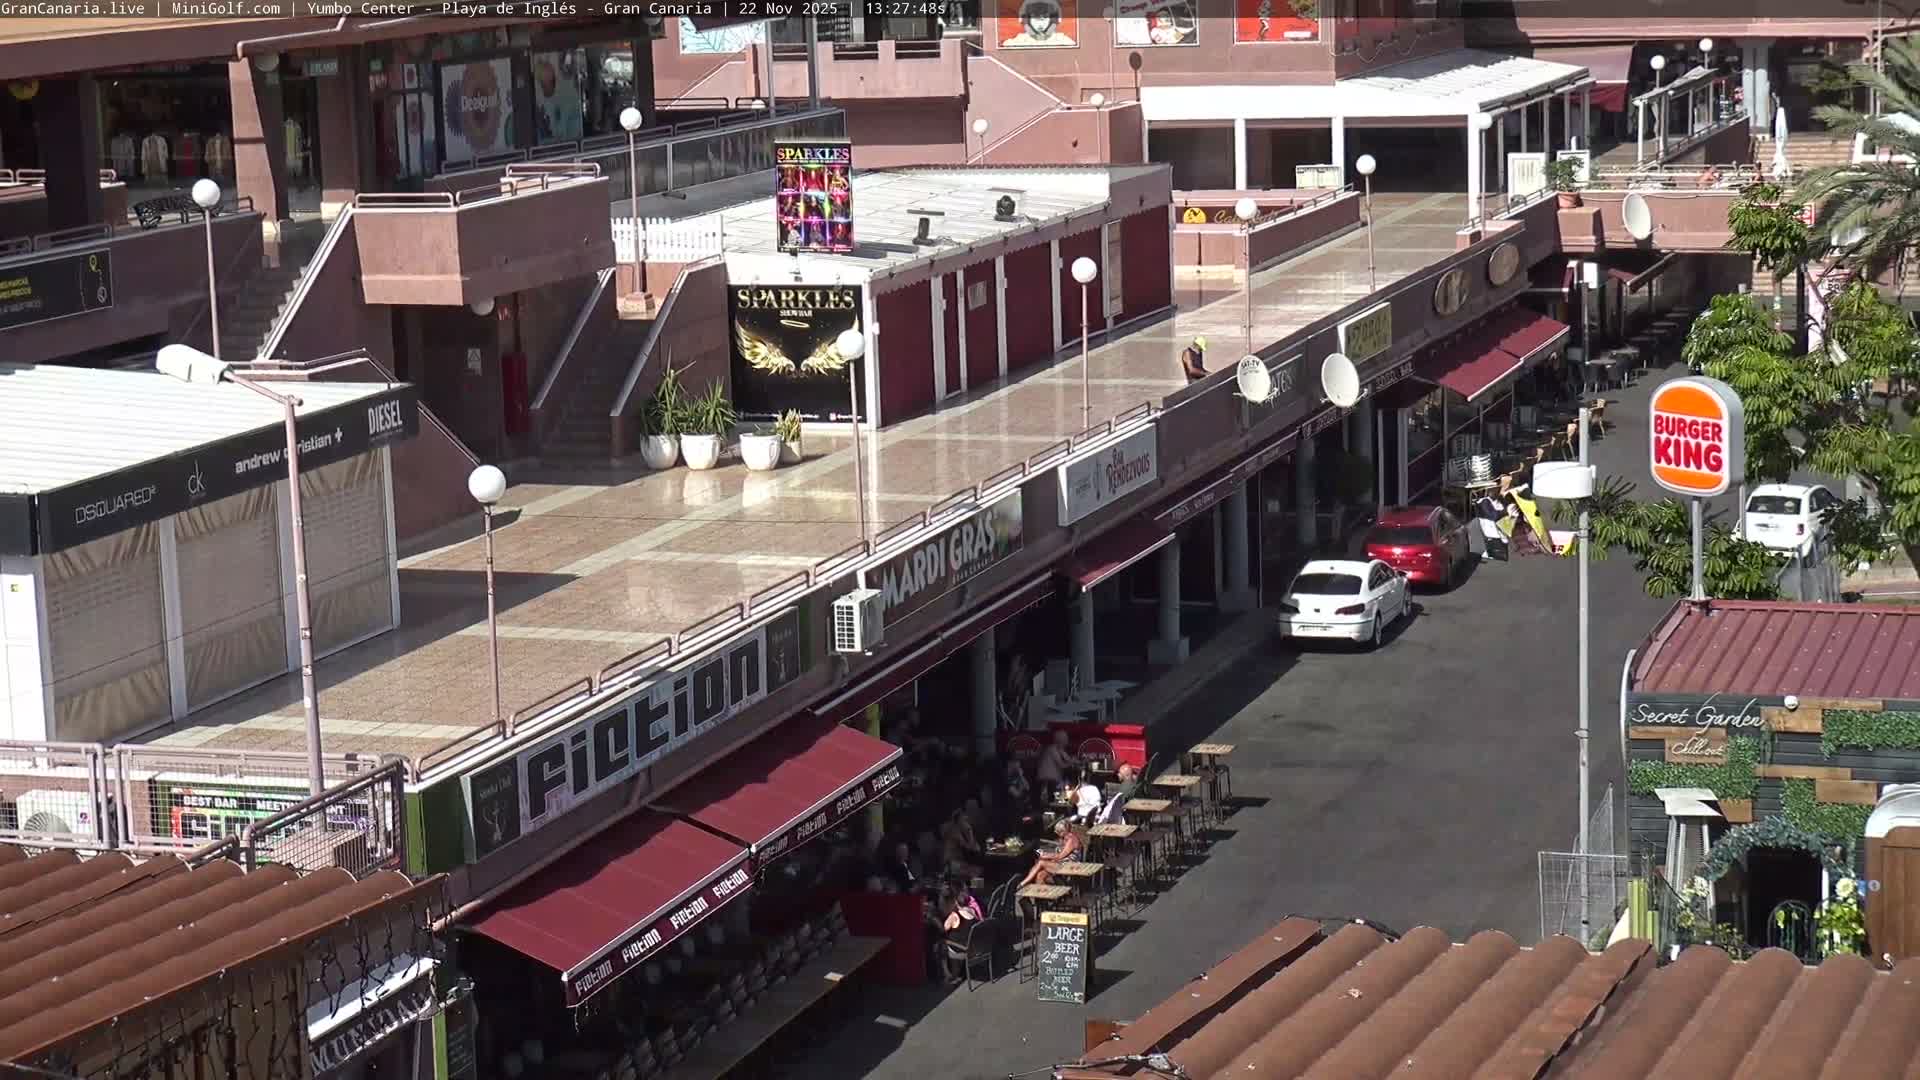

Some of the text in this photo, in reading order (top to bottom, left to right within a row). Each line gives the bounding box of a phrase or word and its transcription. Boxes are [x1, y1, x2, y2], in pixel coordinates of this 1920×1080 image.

[776, 147, 849, 160] SPARKLES
[737, 288, 855, 310] SPARKLES
[367, 399, 403, 435] DIESEL
[1654, 414, 1723, 443] BURGER
[234, 433, 332, 475] andrew cristian
[1654, 435, 1723, 472] KING
[1105, 452, 1151, 495] RENDEZVOUS
[881, 509, 996, 610] MARDI GRAS
[1631, 692, 1765, 735] Secret Garden
[1704, 747, 1724, 756] out
[183, 795, 213, 807] BEST
[214, 797, 238, 809] BAR
[1047, 926, 1085, 943] LARGE
[1054, 942, 1080, 955] BEER
